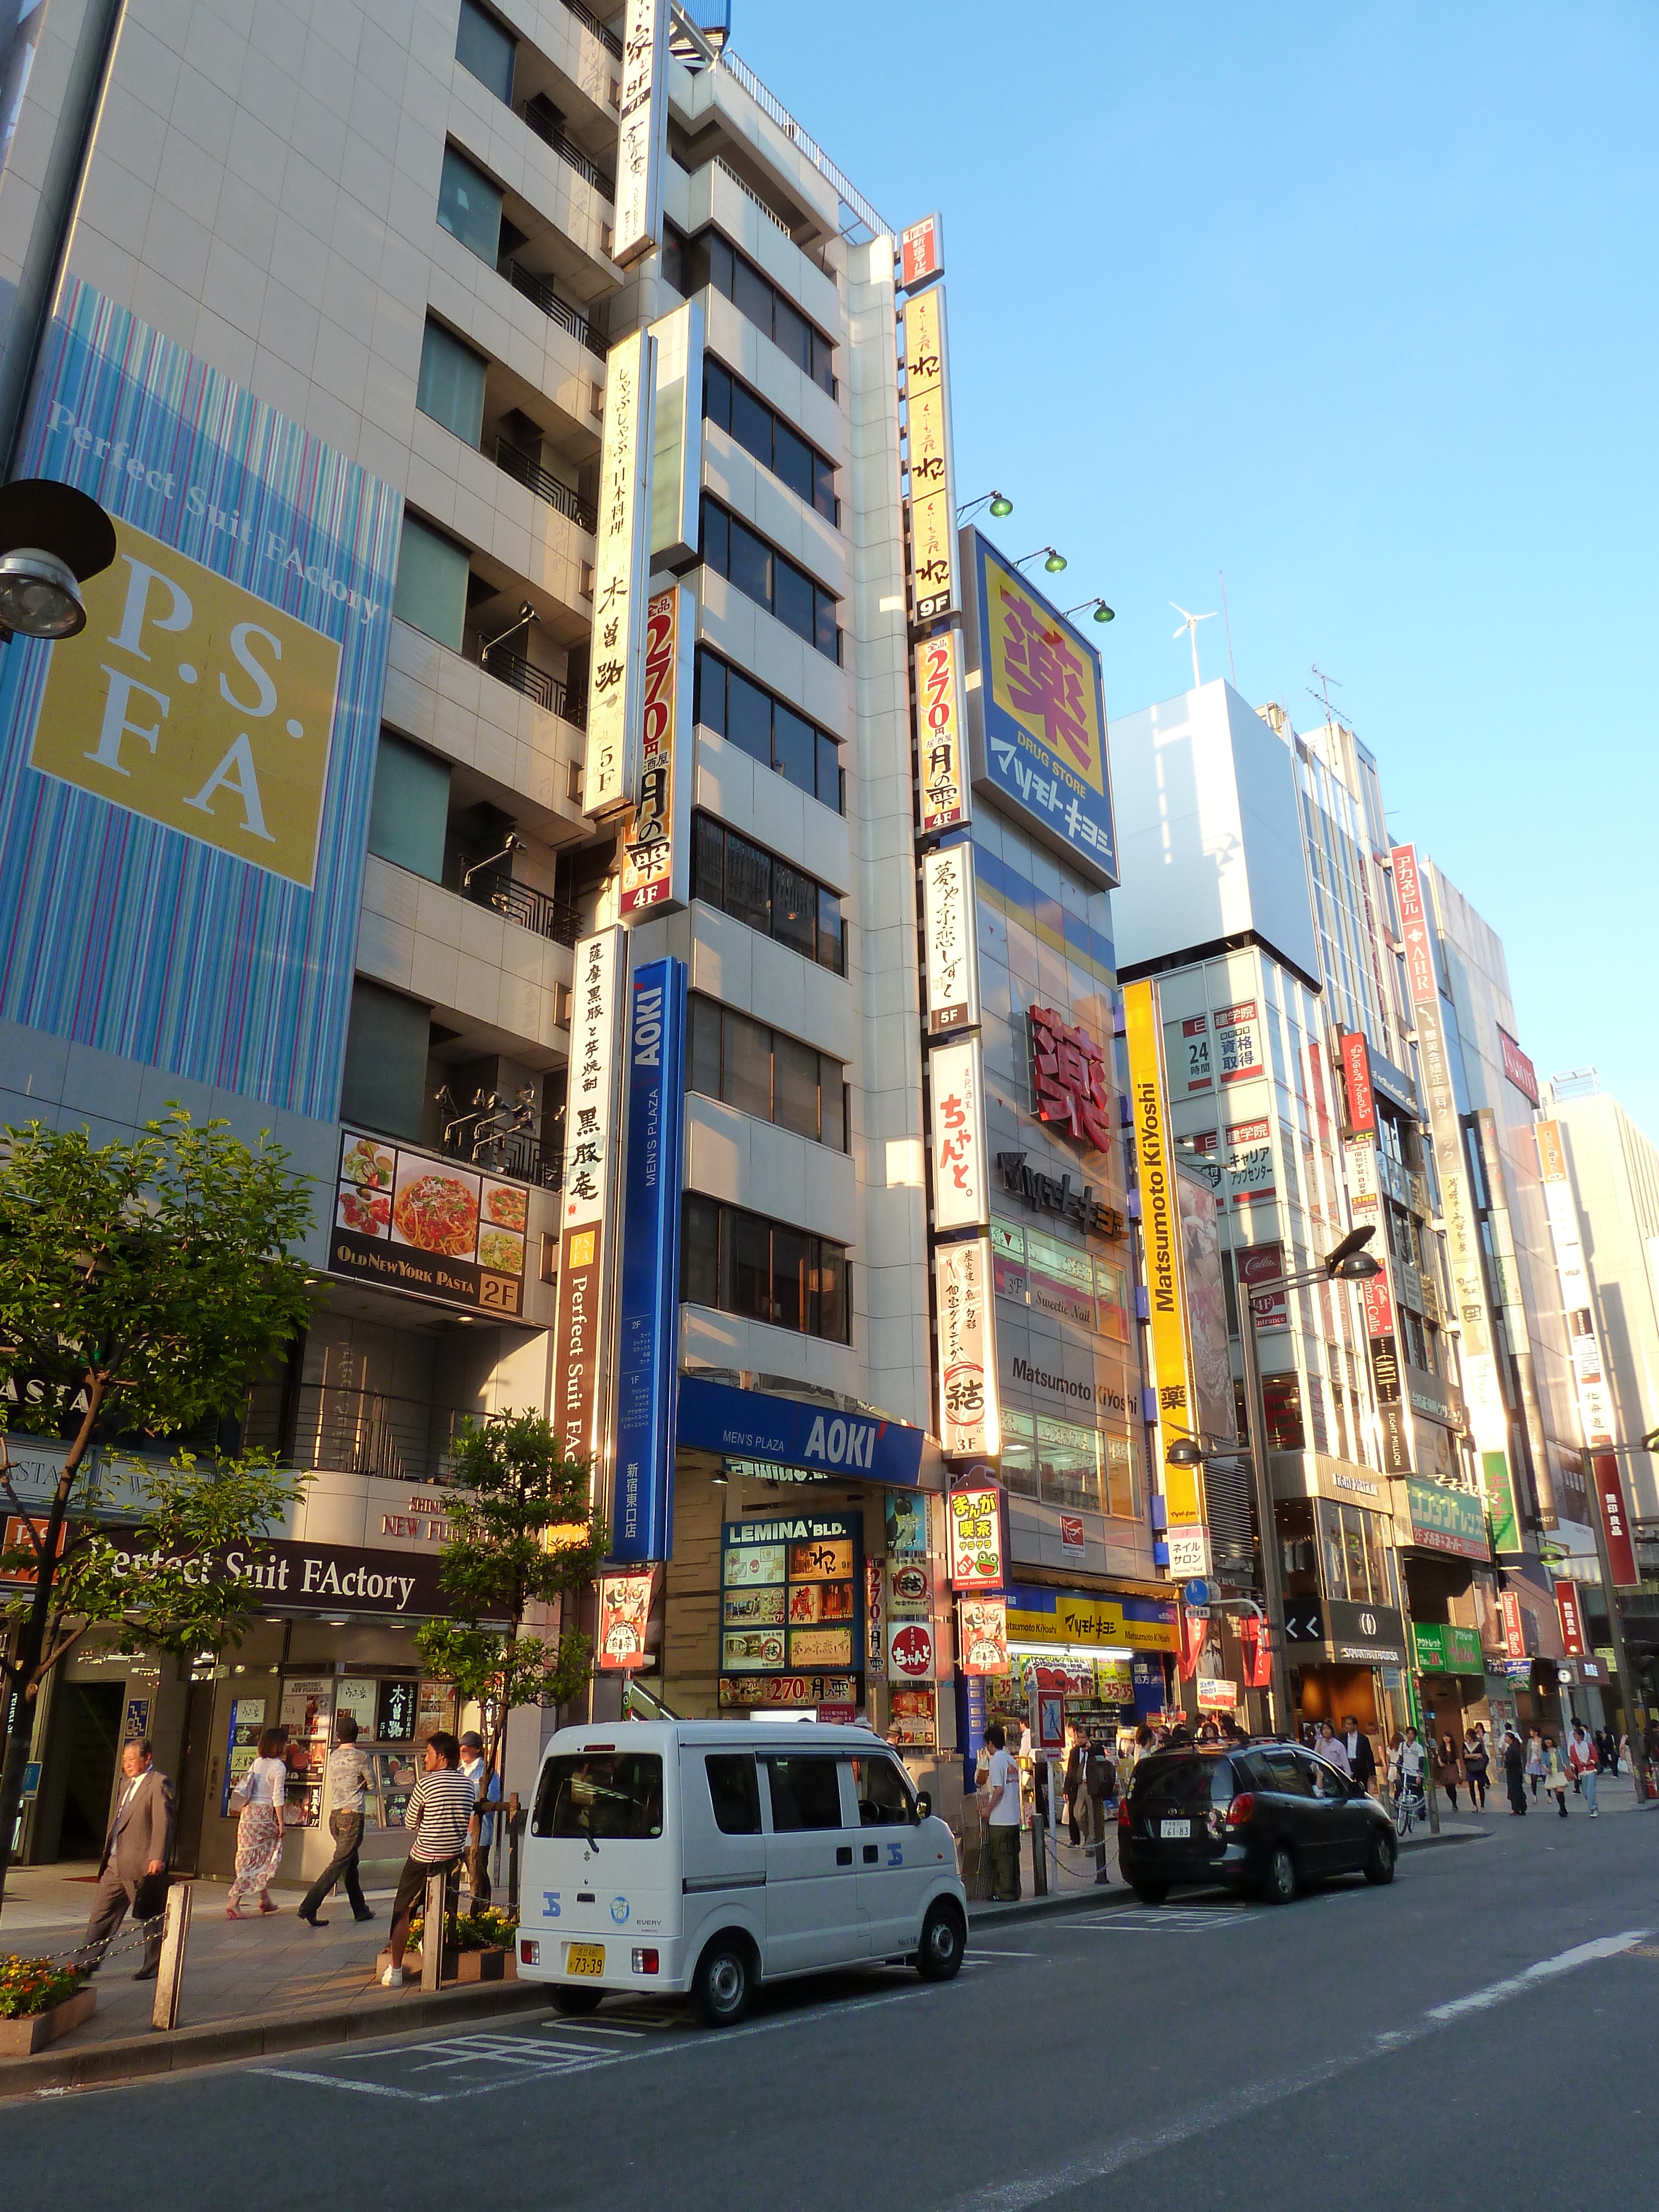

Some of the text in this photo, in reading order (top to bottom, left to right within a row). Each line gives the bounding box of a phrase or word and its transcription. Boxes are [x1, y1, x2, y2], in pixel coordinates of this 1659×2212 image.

[627, 69, 649, 97] 8F
[46, 400, 380, 624] Perfect Suit FActory
[920, 594, 948, 617] 9F
[108, 554, 303, 738] P.S.
[595, 577, 627, 693] 木曽路
[927, 639, 947, 653] 全品
[1000, 584, 1092, 771] 薬
[927, 650, 950, 738] 270円
[84, 664, 275, 842] FA
[926, 734, 953, 748] 居酒屋
[598, 745, 614, 793] 5F
[925, 744, 958, 811] 月の雫
[1017, 730, 1086, 800] DRUG STORE
[933, 811, 952, 827] 4F
[633, 885, 658, 909] 4F
[1396, 856, 1418, 915] アカネビル
[582, 943, 604, 1093] 薩摩黒豚と芋焼酎
[634, 986, 662, 1066] AOKI
[940, 1009, 958, 1024] 5F
[1190, 1042, 1209, 1064] 24
[1221, 1036, 1252, 1054] 資格
[1191, 1063, 1209, 1076] 時間
[1223, 1051, 1254, 1070] 取得
[1029, 1004, 1112, 1154] 薬
[1351, 1045, 1370, 1119] SAIGON NOODLE
[646, 1087, 659, 1187] MEN'S PLAZA
[940, 1094, 973, 1197] ちゃんと。
[568, 1105, 603, 1201] 黒豚庵
[1230, 1147, 1270, 1167] キャリア
[1231, 1168, 1273, 1185] アップセンター
[1138, 1082, 1174, 1312] Matsumoto KiYoshi
[1352, 1194, 1376, 1204] 24時間
[483, 1281, 514, 1306] 2F
[1008, 1278, 1091, 1324] 3F Sweetie Nail
[1255, 1299, 1271, 1311] 4F
[572, 1275, 588, 1357] Perfect
[632, 1321, 641, 1329] 2F
[946, 1285, 964, 1361] 個室ダイニング
[567, 1364, 584, 1411] Suit
[631, 1375, 639, 1384] 1F
[1013, 1357, 1137, 1415] Matsumoto KiYoshi
[946, 1379, 984, 1411] 結
[1161, 1385, 1186, 1410] 薬
[723, 1416, 875, 1469] MEN'S PLAZA AOKI
[957, 1437, 976, 1451] 3F
[1389, 1412, 1402, 1467] EIGHT MILLION
[625, 1462, 638, 1538] 新宿東口店
[952, 1494, 998, 1519] まんが
[382, 1514, 420, 1537] NEW
[1605, 1494, 1623, 1536] 無印良品
[813, 1523, 847, 1536] BLD.
[959, 1520, 992, 1539] 喫茶
[1413, 1527, 1423, 1541] 2F
[808, 1545, 836, 1574] わん
[1172, 1542, 1201, 1553] ネイル
[1173, 1554, 1201, 1565] サロン
[958, 1558, 972, 1574] B1F
[227, 1552, 415, 1610] Suit FActory
[1005, 1623, 1057, 1634] atsumoto KiYoshi
[1563, 1601, 1576, 1636] 無印良品
[1125, 1631, 1171, 1642] Matsumoto KiYoshi
[1417, 1638, 1442, 1647] アウトレット
[614, 1653, 627, 1663] 7F
[868, 1630, 884, 1672] 月の雫
[978, 1663, 992, 1671] 7F
[810, 1677, 849, 1702] 月の雫
[388, 1684, 406, 1738] 木曽路
[380, 1722, 385, 1738] 5F
[575, 1958, 602, 1974] 73-39
